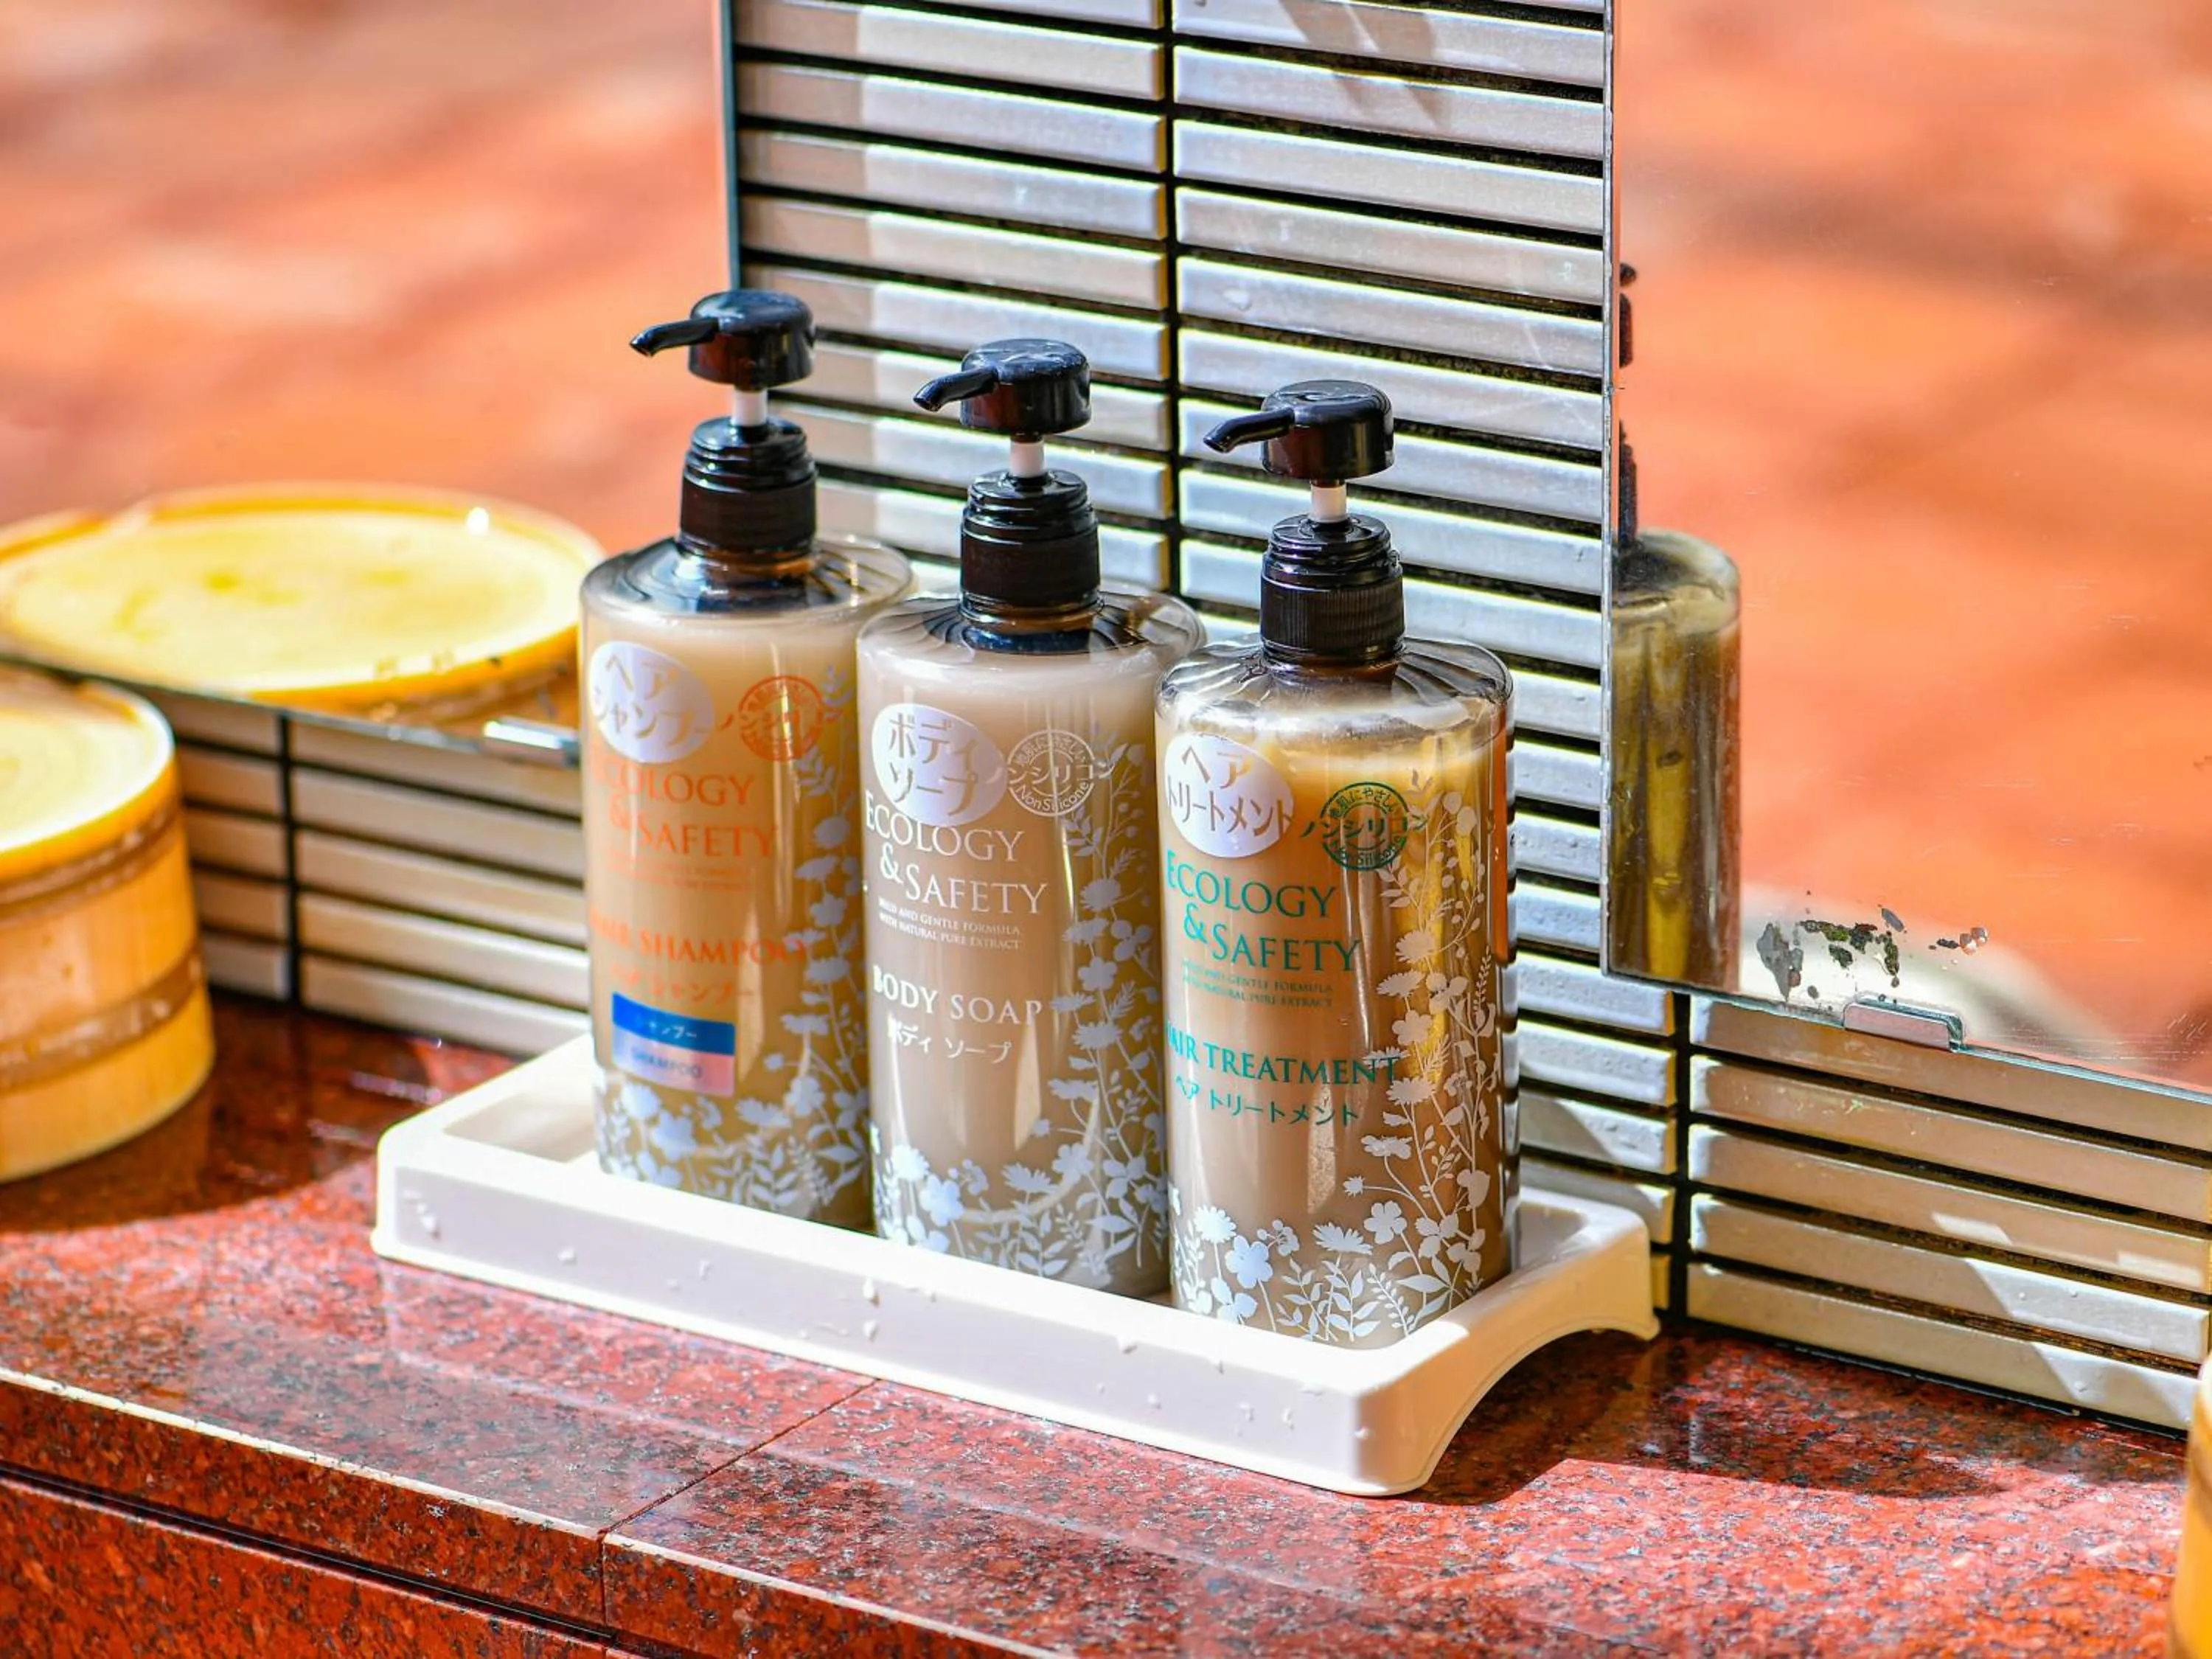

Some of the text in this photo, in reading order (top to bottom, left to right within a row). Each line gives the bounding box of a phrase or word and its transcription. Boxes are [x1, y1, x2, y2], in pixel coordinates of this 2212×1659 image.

[605, 654, 678, 700] ヘア
[888, 712, 977, 771] ボディ
[888, 762, 978, 816] ソープ
[1181, 745, 1251, 789] ヘア
[866, 790, 1025, 862] ECOLOGY
[1167, 774, 1295, 838] トリートメント
[1167, 849, 1336, 918] ECOLOGY
[950, 994, 1043, 1026] SOAP
[945, 1037, 1012, 1065] ソープ
[1203, 1041, 1397, 1085] TREATMENT
[1209, 1088, 1359, 1127] トリートメント
